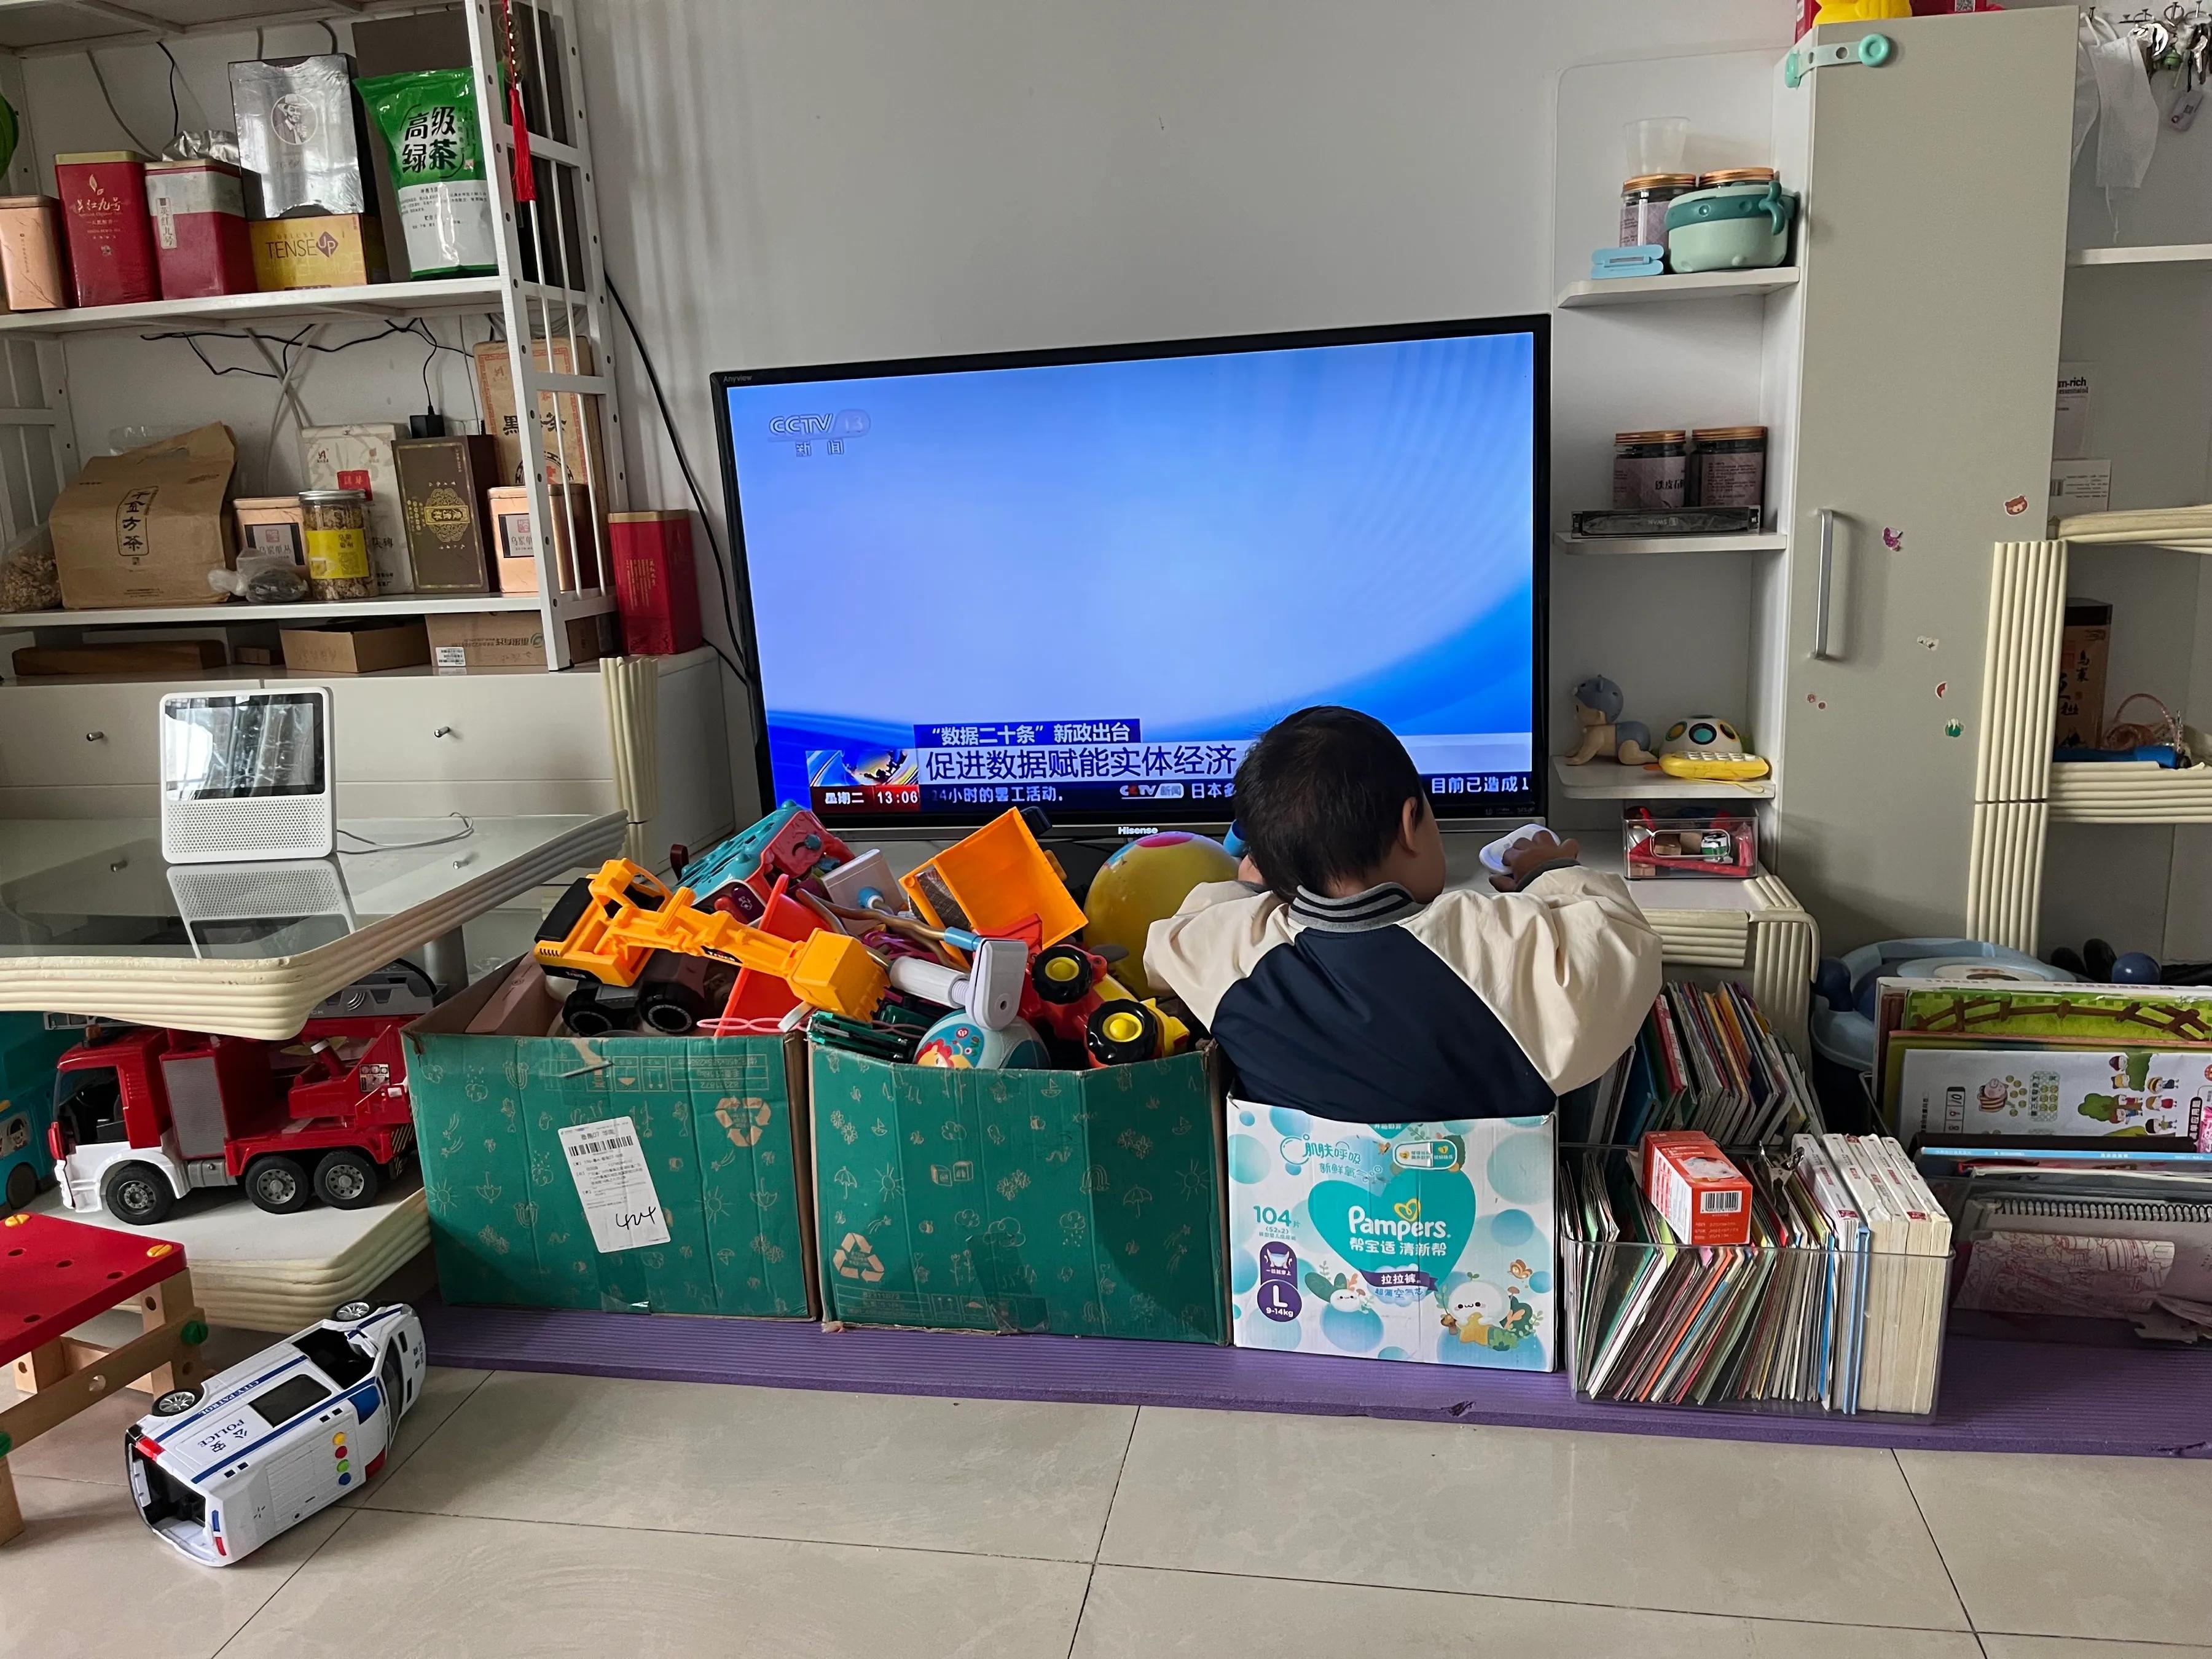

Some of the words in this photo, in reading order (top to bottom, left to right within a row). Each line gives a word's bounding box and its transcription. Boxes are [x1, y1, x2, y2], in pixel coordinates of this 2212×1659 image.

[405, 106, 456, 141] 高级
[402, 138, 457, 174] 绿茶
[265, 238, 317, 259] TENSE
[769, 413, 834, 434] CCTV
[1054, 723, 1131, 743] 新政出台
[925, 743, 1237, 781] 促进数据赋能实体经济
[877, 791, 919, 804] 13:06
[1118, 826, 1159, 835] Hisense
[1303, 1142, 1361, 1165] 肌肤呼吸
[1253, 1205, 1292, 1227] 104
[1348, 1205, 1448, 1241] Pampers
[1349, 1236, 1395, 1254] 帮宝适
[1399, 1241, 1447, 1257] 清新帮
[1381, 1273, 1416, 1285] 拉拉裤
[1273, 1285, 1288, 1308] L
[1266, 1307, 1293, 1317] 9-14kg
[197, 1419, 245, 1448] POLICE
